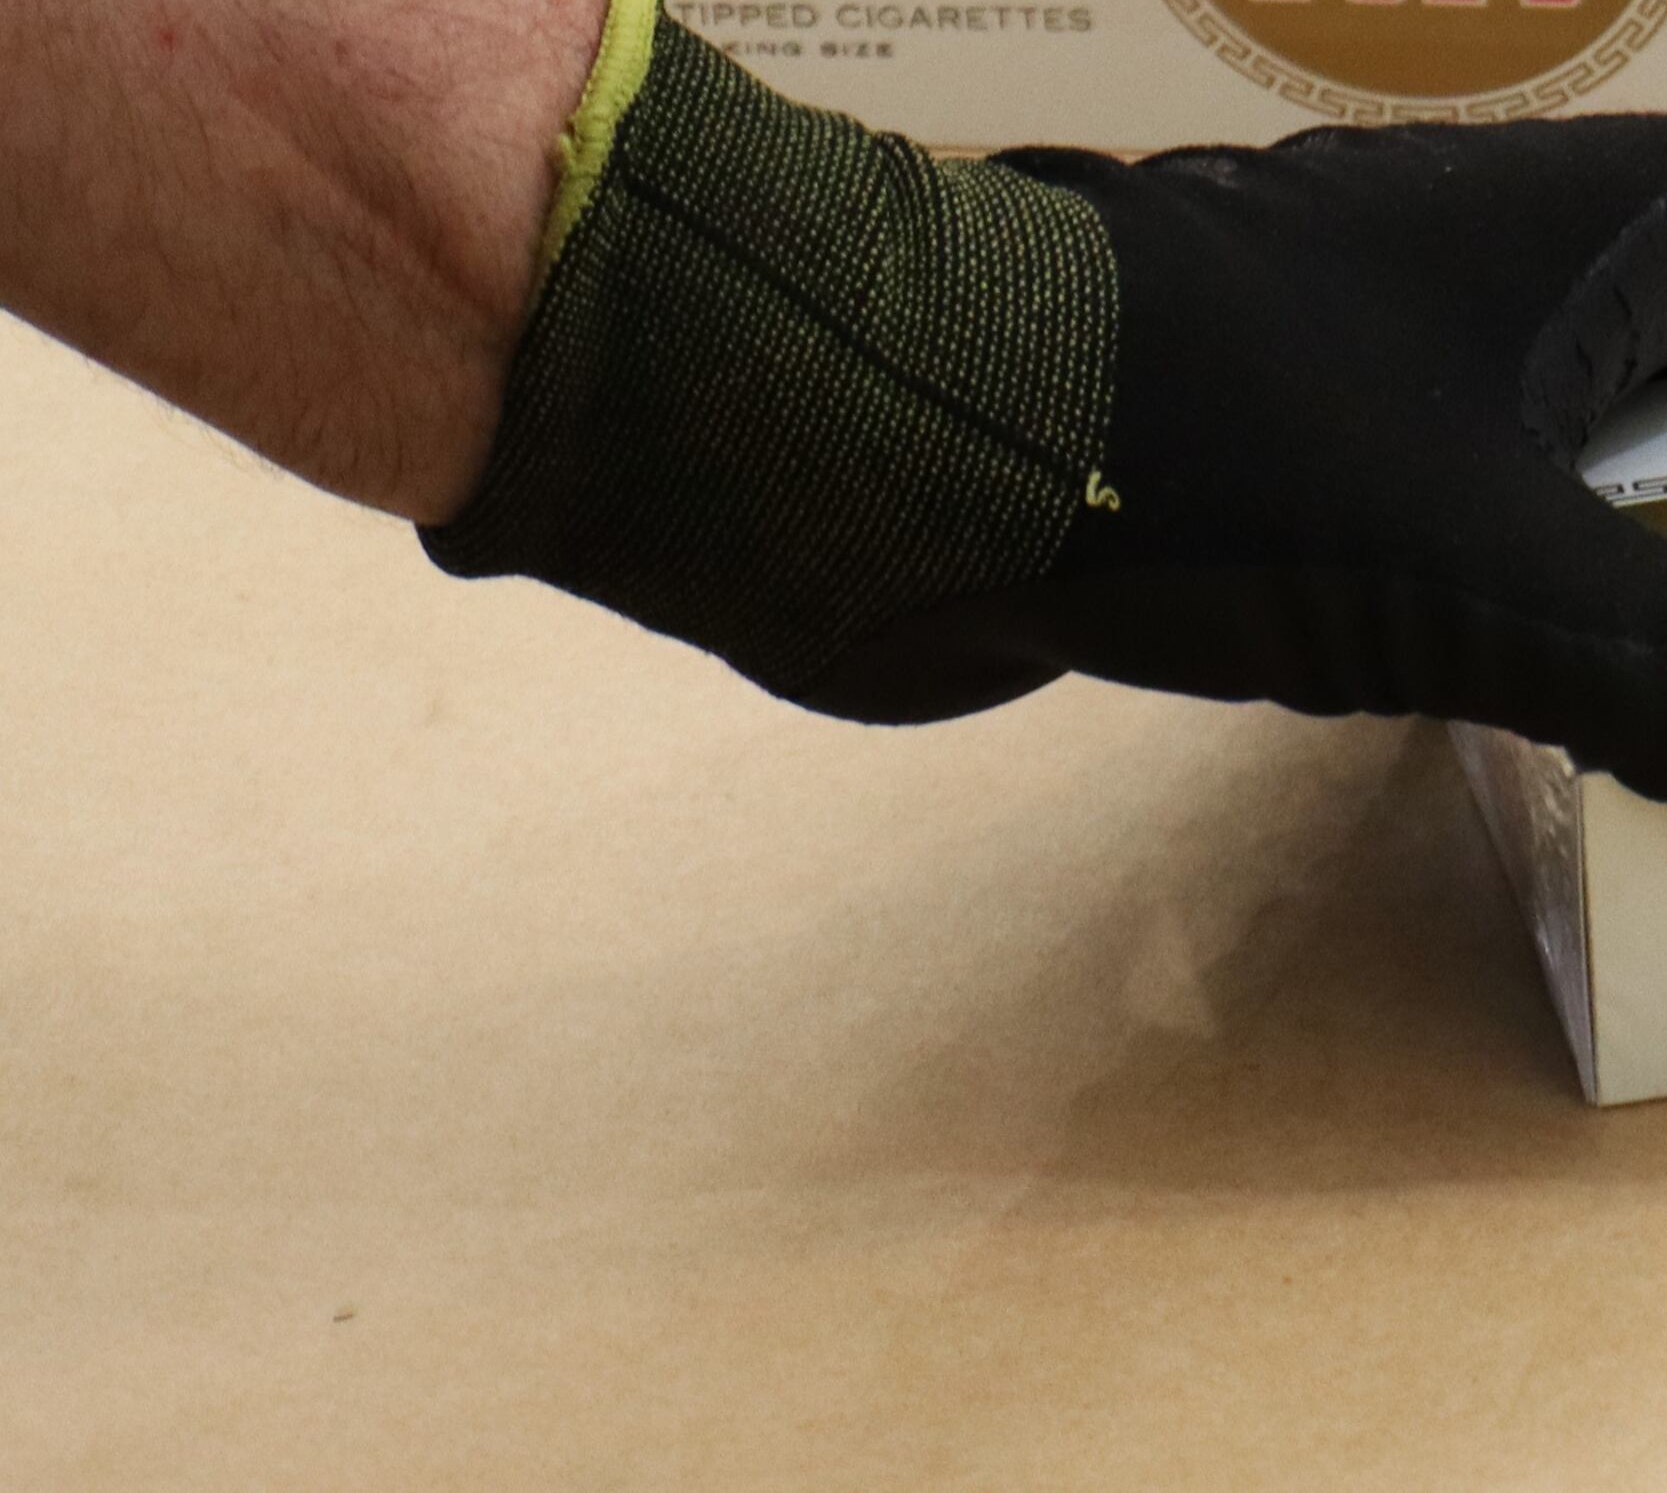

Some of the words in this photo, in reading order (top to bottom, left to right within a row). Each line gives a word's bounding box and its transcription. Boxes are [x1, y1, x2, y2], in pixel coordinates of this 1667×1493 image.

[677, 1, 818, 30] TIPPED
[834, 2, 1095, 34] CIGARETTES
[819, 41, 894, 59] SIZE
